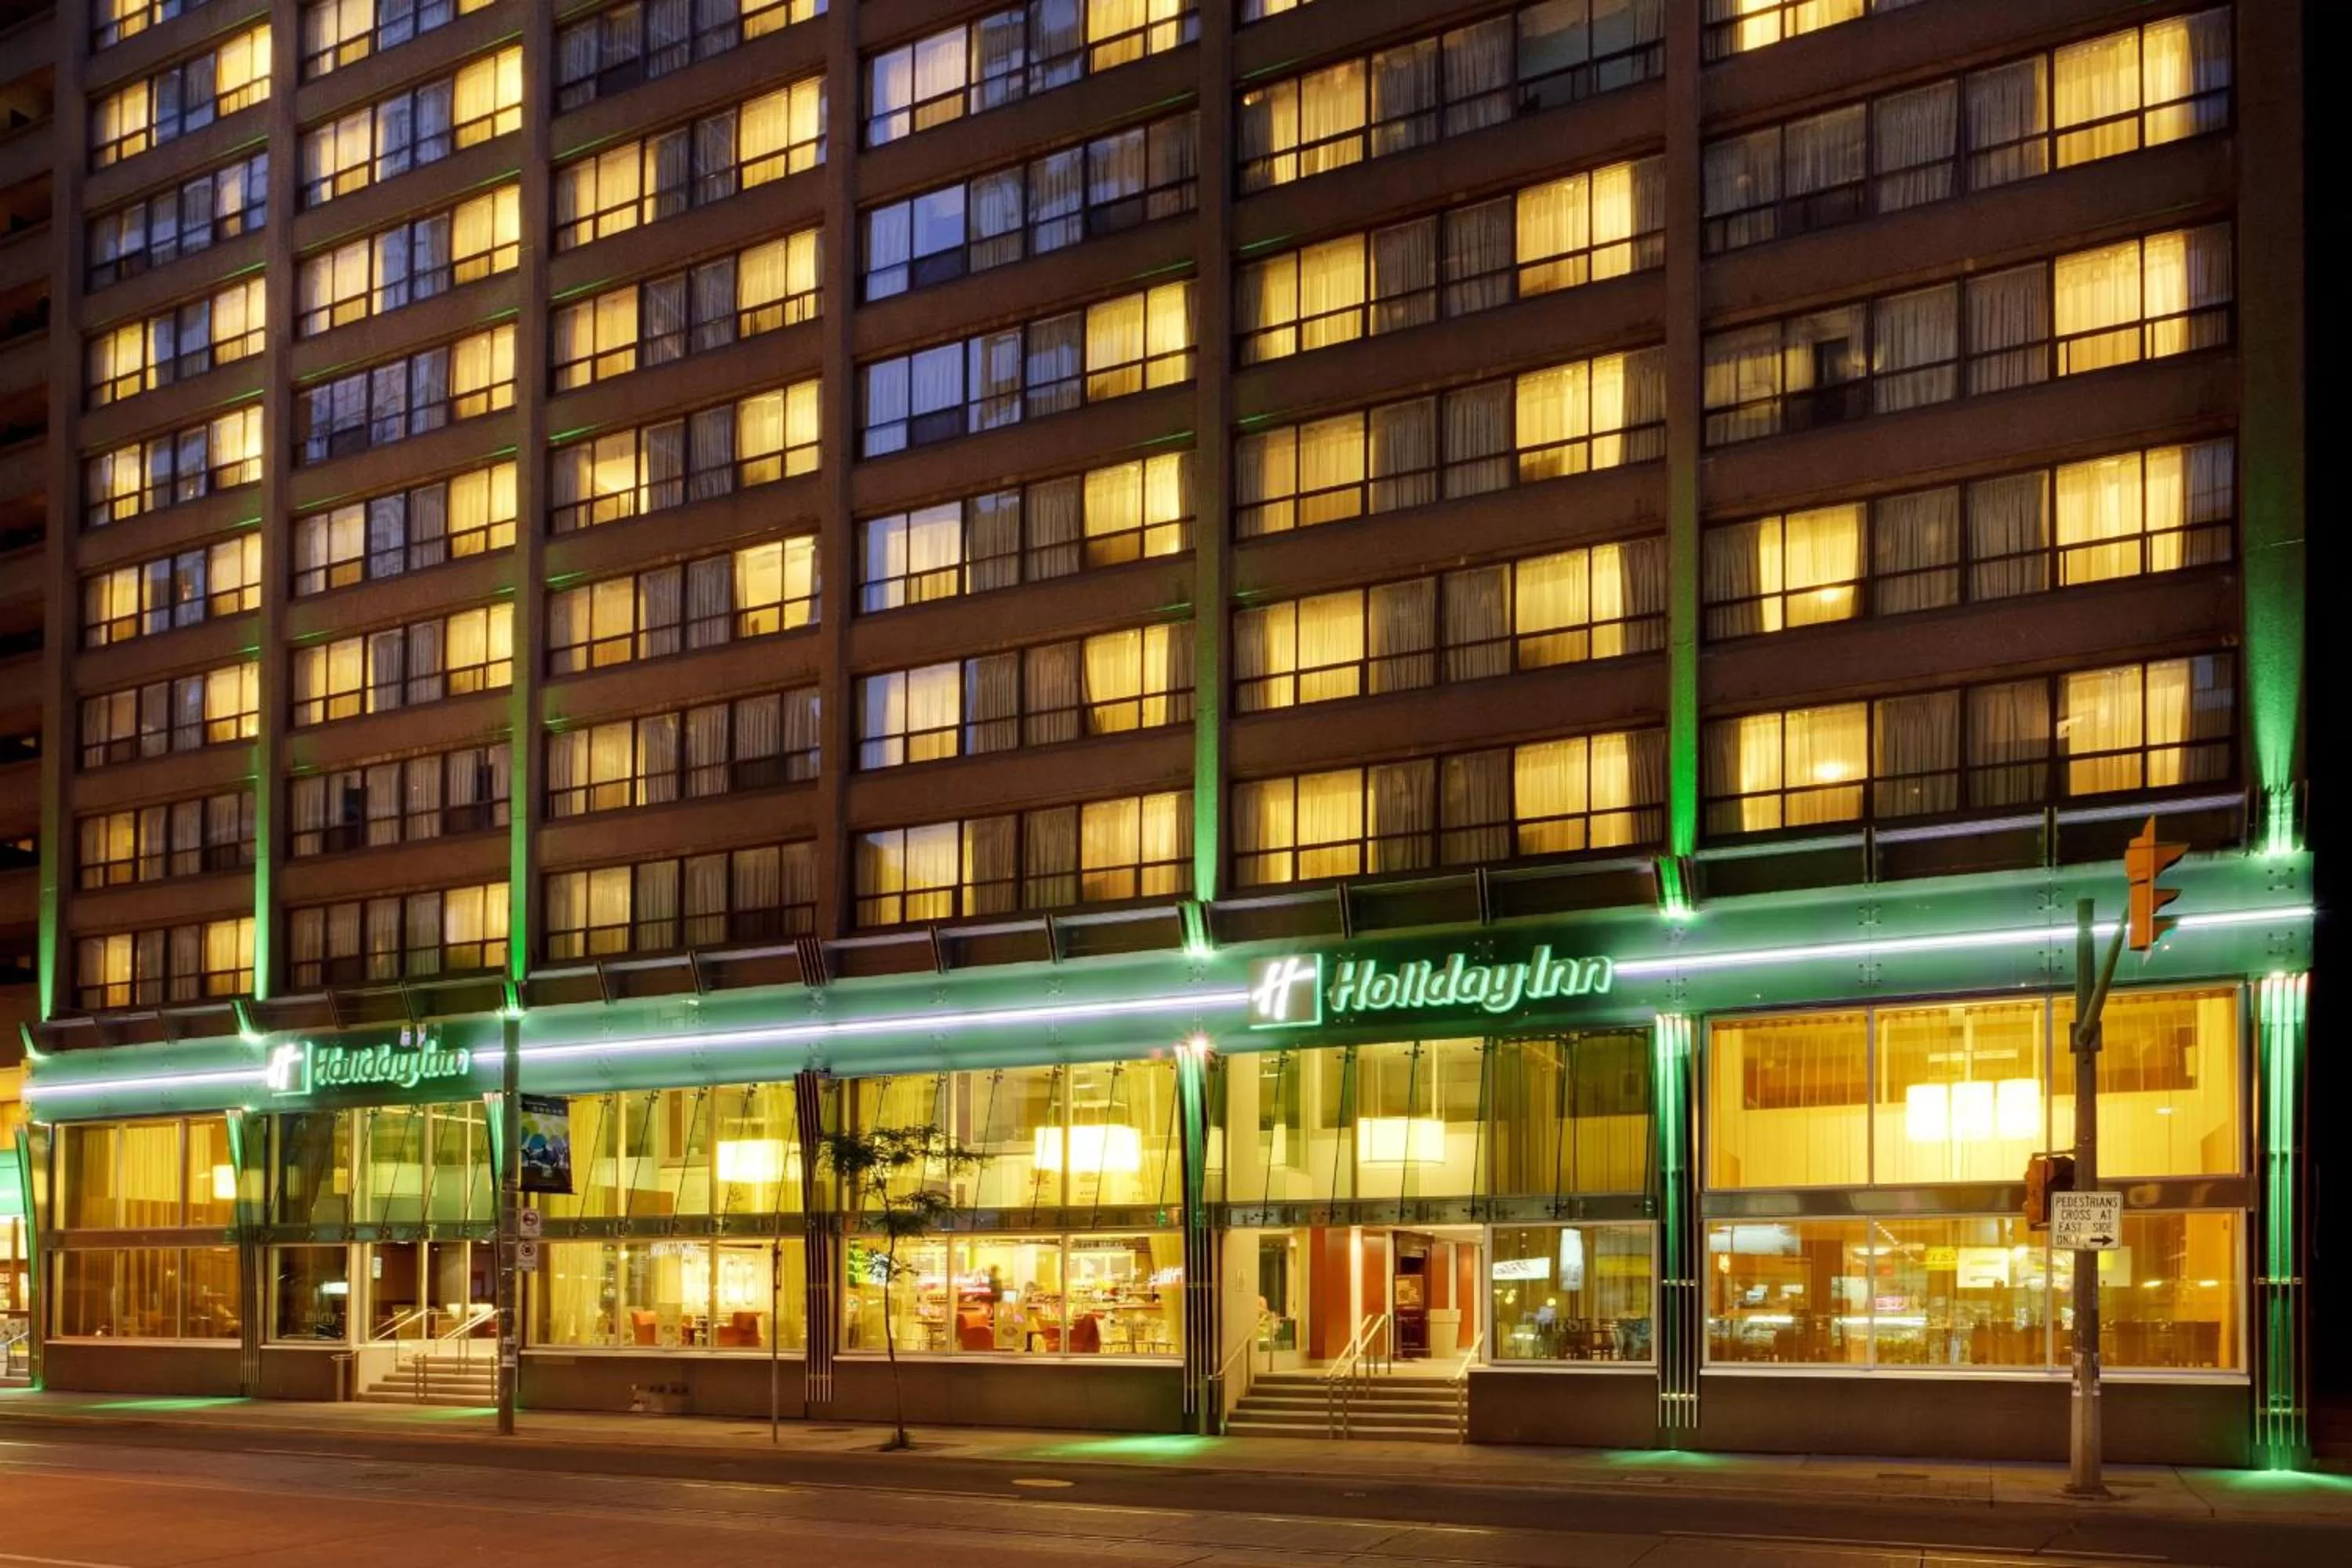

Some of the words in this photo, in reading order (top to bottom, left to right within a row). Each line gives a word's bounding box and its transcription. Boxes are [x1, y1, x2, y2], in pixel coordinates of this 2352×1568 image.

[1330, 952, 1526, 1014] Holiday
[1526, 944, 1613, 999] Inn
[2055, 1196, 2118, 1208] PEDESTRIANS
[2060, 1208, 2092, 1221] CROSS
[2100, 1208, 2112, 1221] AT
[2058, 1221, 2082, 1233] EAST
[2092, 1222, 2113, 1233] SIDE
[2056, 1235, 2080, 1246] ONLY
